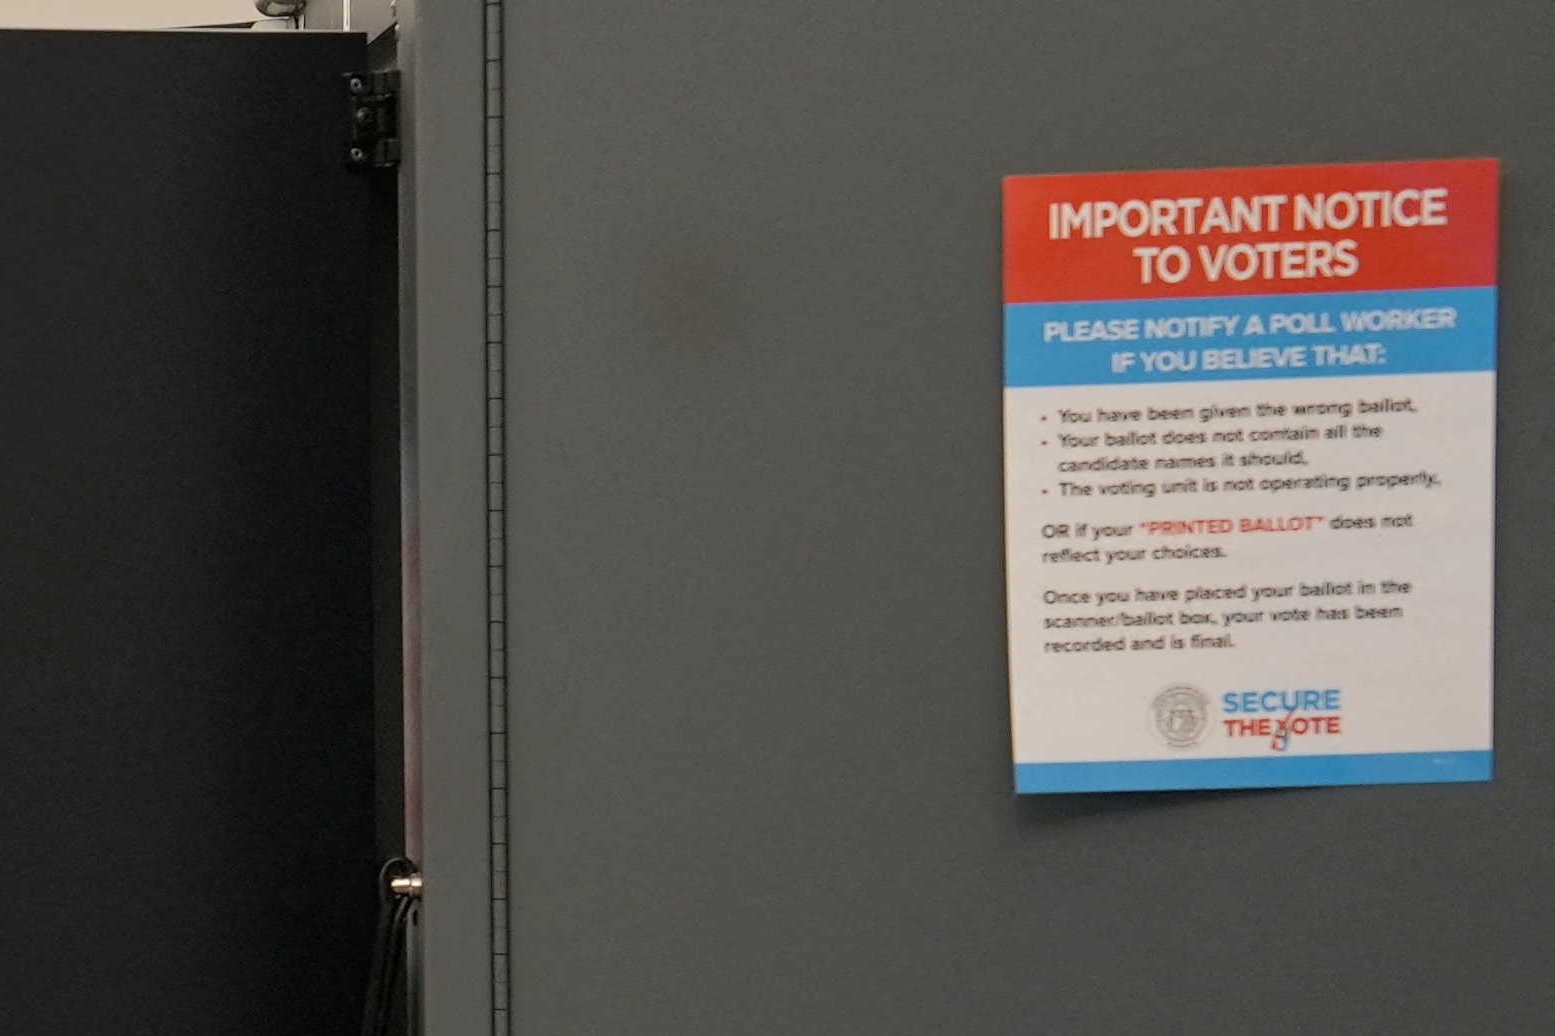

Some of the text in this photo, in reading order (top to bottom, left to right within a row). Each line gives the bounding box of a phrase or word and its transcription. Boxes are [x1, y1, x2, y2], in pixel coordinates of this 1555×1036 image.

[1048, 188, 1448, 240] IMPORTANT NOTICE
[1133, 239, 1359, 284] TO VOTERS
[1043, 307, 1456, 342] PLEASE NOTIFY A POLL WORKER
[1111, 342, 1386, 373] IF YOU BELIEVE THAT:
[1057, 408, 1092, 423] You
[1096, 407, 1143, 422] have
[1147, 406, 1195, 421] been
[1199, 404, 1251, 423] given
[1256, 402, 1288, 416] the
[1293, 402, 1354, 418] wrong
[1057, 423, 1383, 448] Your ballot does not contain all the
[1058, 457, 1149, 472] candidate
[1154, 456, 1217, 469] names
[1221, 452, 1234, 467] it
[1057, 482, 1093, 497] The
[1097, 480, 1157, 498] voting
[1161, 478, 1198, 493] unit
[1203, 477, 1218, 492] is
[1222, 477, 1254, 491] not
[1259, 474, 1351, 493] operating
[1042, 524, 1070, 539] OR
[1075, 522, 1089, 537] if
[1091, 525, 1134, 541] your
[1329, 513, 1377, 529] does
[1381, 512, 1414, 528] not
[1042, 548, 1100, 563] reflect
[1104, 549, 1146, 565] your
[1043, 580, 1412, 606] Once you have placed your ballot in the
[1043, 611, 1174, 629] scanner/ballot
[1222, 611, 1265, 627] your
[1270, 609, 1311, 622] vote
[1315, 606, 1349, 620] has
[1354, 604, 1404, 620] been
[1044, 637, 1126, 652] recorded
[1130, 635, 1166, 650] and
[1170, 634, 1186, 649] is
[1222, 688, 1341, 714] SECURE
[1222, 718, 1271, 737] THE
